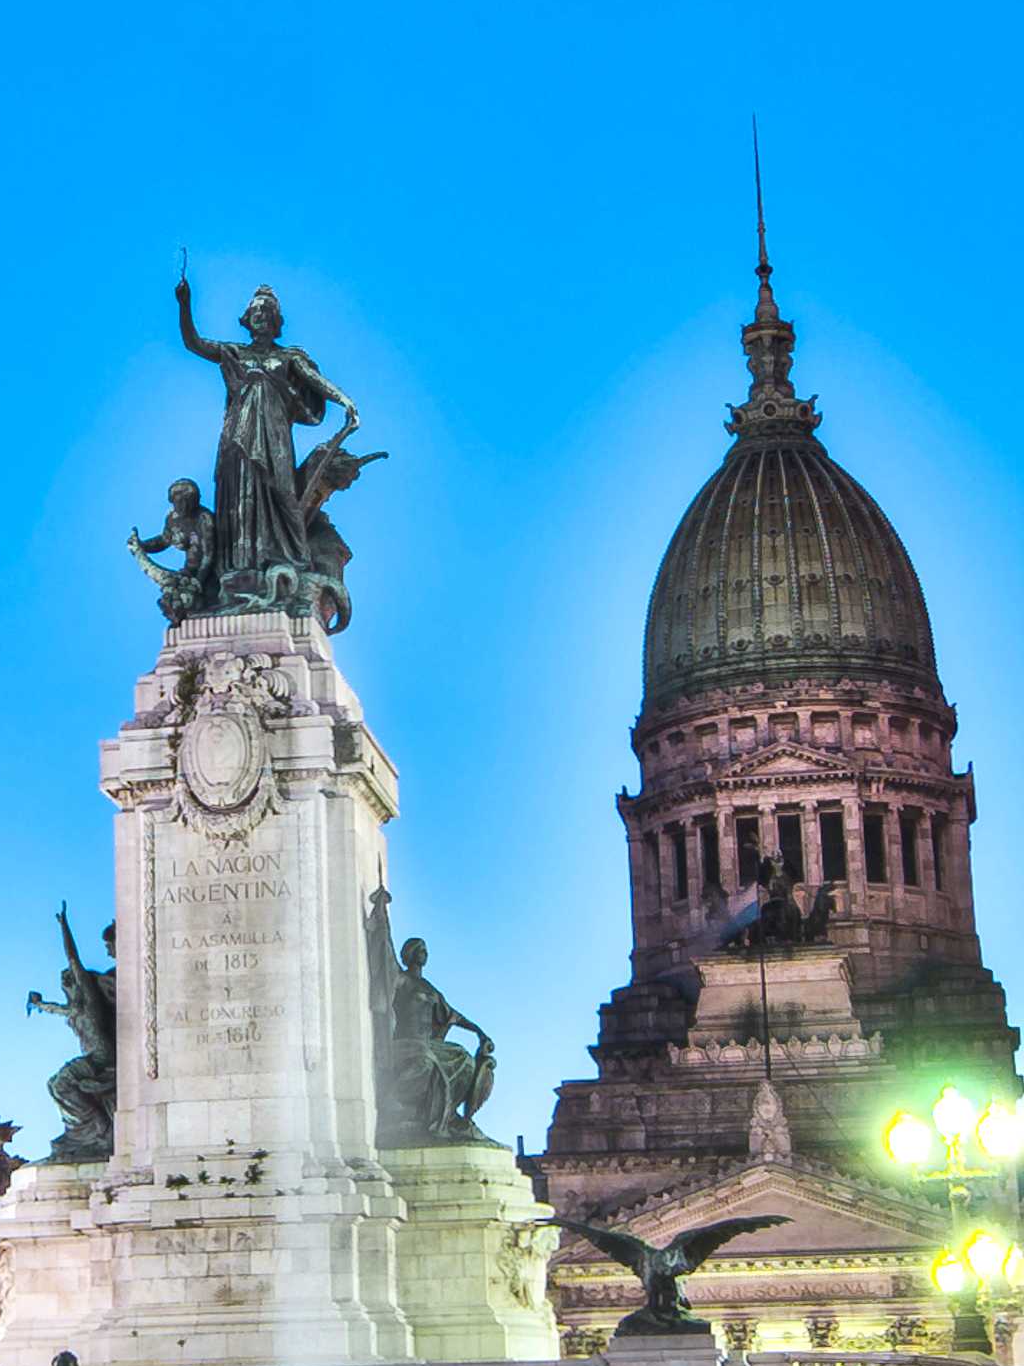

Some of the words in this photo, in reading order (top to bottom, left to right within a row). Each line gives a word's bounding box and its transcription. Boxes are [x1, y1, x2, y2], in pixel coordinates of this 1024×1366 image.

[172, 859, 199, 876] LA
[206, 853, 281, 875] NACION
[162, 880, 291, 904] ARGENTINA
[172, 936, 192, 949] LA
[224, 952, 259, 971] 1813
